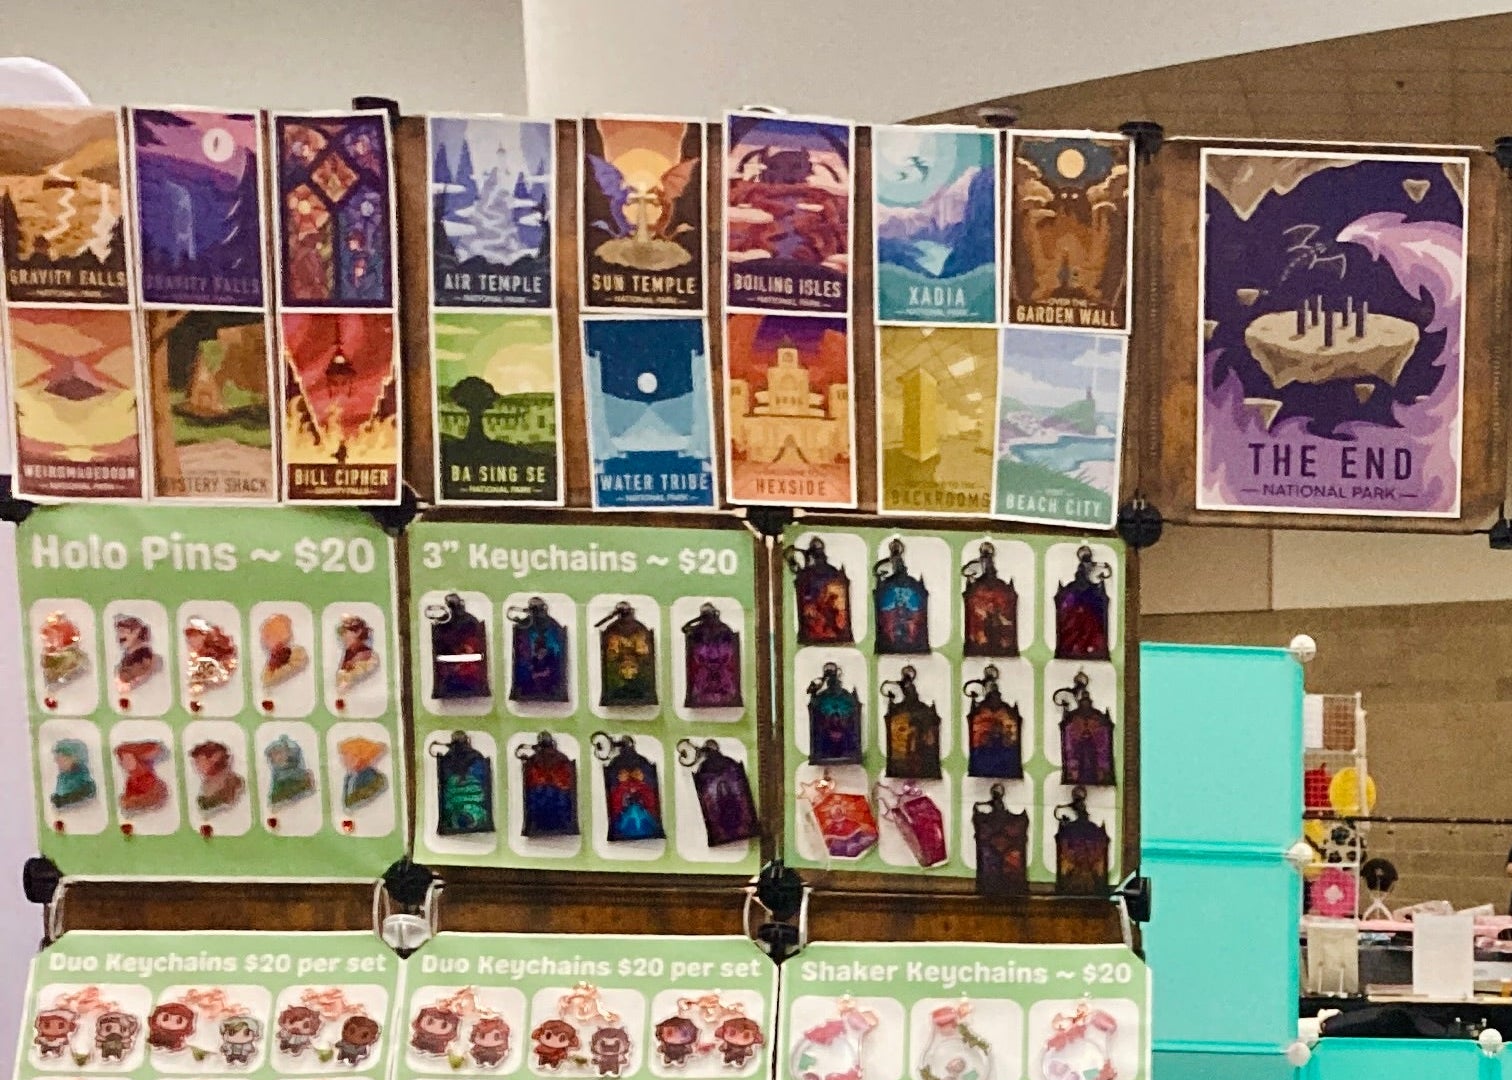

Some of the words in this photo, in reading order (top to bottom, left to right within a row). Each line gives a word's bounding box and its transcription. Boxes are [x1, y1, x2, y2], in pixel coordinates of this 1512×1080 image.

[9, 268, 71, 286] GRAVITY
[80, 270, 126, 288] FALLS
[443, 272, 470, 290] AIR
[479, 273, 543, 293] TEMPLE
[591, 274, 624, 292] SUN
[631, 275, 697, 294] TEMPLE
[733, 273, 794, 294] BOILING
[798, 278, 842, 298] ISLES
[909, 286, 965, 306] XADIA
[1016, 305, 1074, 324] GARDEN
[1079, 308, 1119, 327] WALL
[1247, 442, 1317, 478] THE
[1340, 446, 1413, 480] END
[223, 476, 268, 493] SHACK
[293, 468, 328, 487] BILL
[333, 468, 390, 487] CIPHER
[450, 465, 473, 483] BA
[478, 465, 519, 483] SING
[525, 466, 546, 484] SE
[599, 472, 654, 491] WATER
[660, 472, 709, 491] TRIBE
[755, 478, 827, 497] HEXSIDE
[1262, 483, 1347, 499] NATIONAL
[1352, 486, 1395, 500] PARK
[1006, 493, 1057, 513] BEACH
[1064, 498, 1101, 518] CITY
[30, 533, 128, 571] Holo
[141, 533, 238, 572] Pins
[295, 538, 376, 573] $20
[468, 542, 637, 578] Keychains
[678, 548, 739, 577] $20
[49, 952, 99, 972] Duo
[105, 951, 237, 977] Keychains
[244, 953, 292, 974] $20
[297, 956, 340, 977] per
[346, 954, 387, 973] set
[421, 955, 470, 974] Duo
[478, 955, 612, 980] Keychains
[618, 957, 665, 978] $20
[670, 959, 714, 981] per
[720, 958, 763, 978] set
[801, 960, 899, 982] Shaker
[906, 960, 1048, 988] Keychains
[1083, 962, 1133, 985] $20
